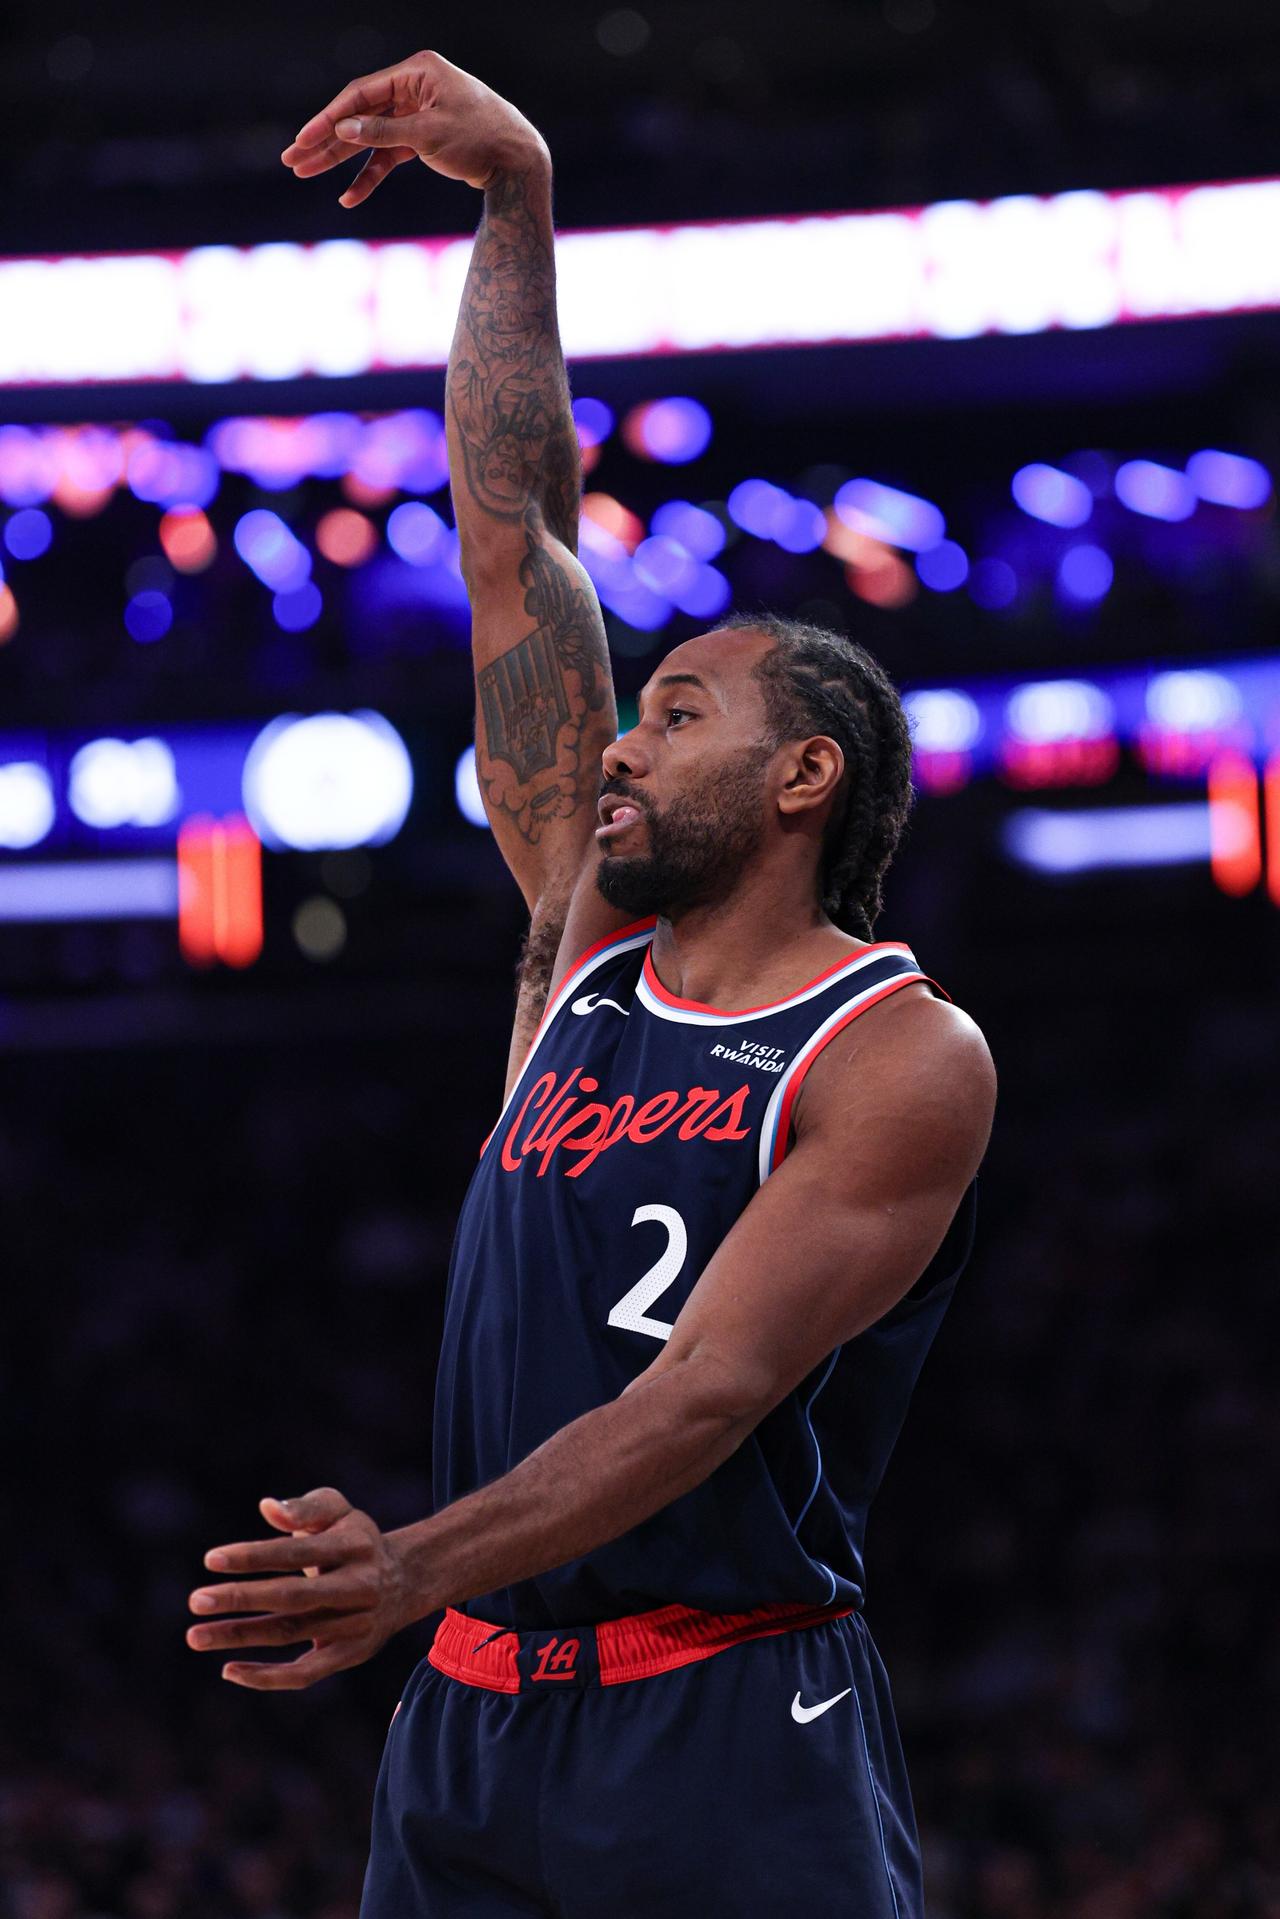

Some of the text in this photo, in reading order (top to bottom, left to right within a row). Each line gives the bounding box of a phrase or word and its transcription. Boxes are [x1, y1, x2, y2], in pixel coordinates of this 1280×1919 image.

[710, 1044, 785, 1072] RWANDA
[740, 1040, 785, 1059] VISIT
[501, 1067, 751, 1178] Clippers
[607, 1204, 688, 1341] 2
[531, 1638, 580, 1681] LA
